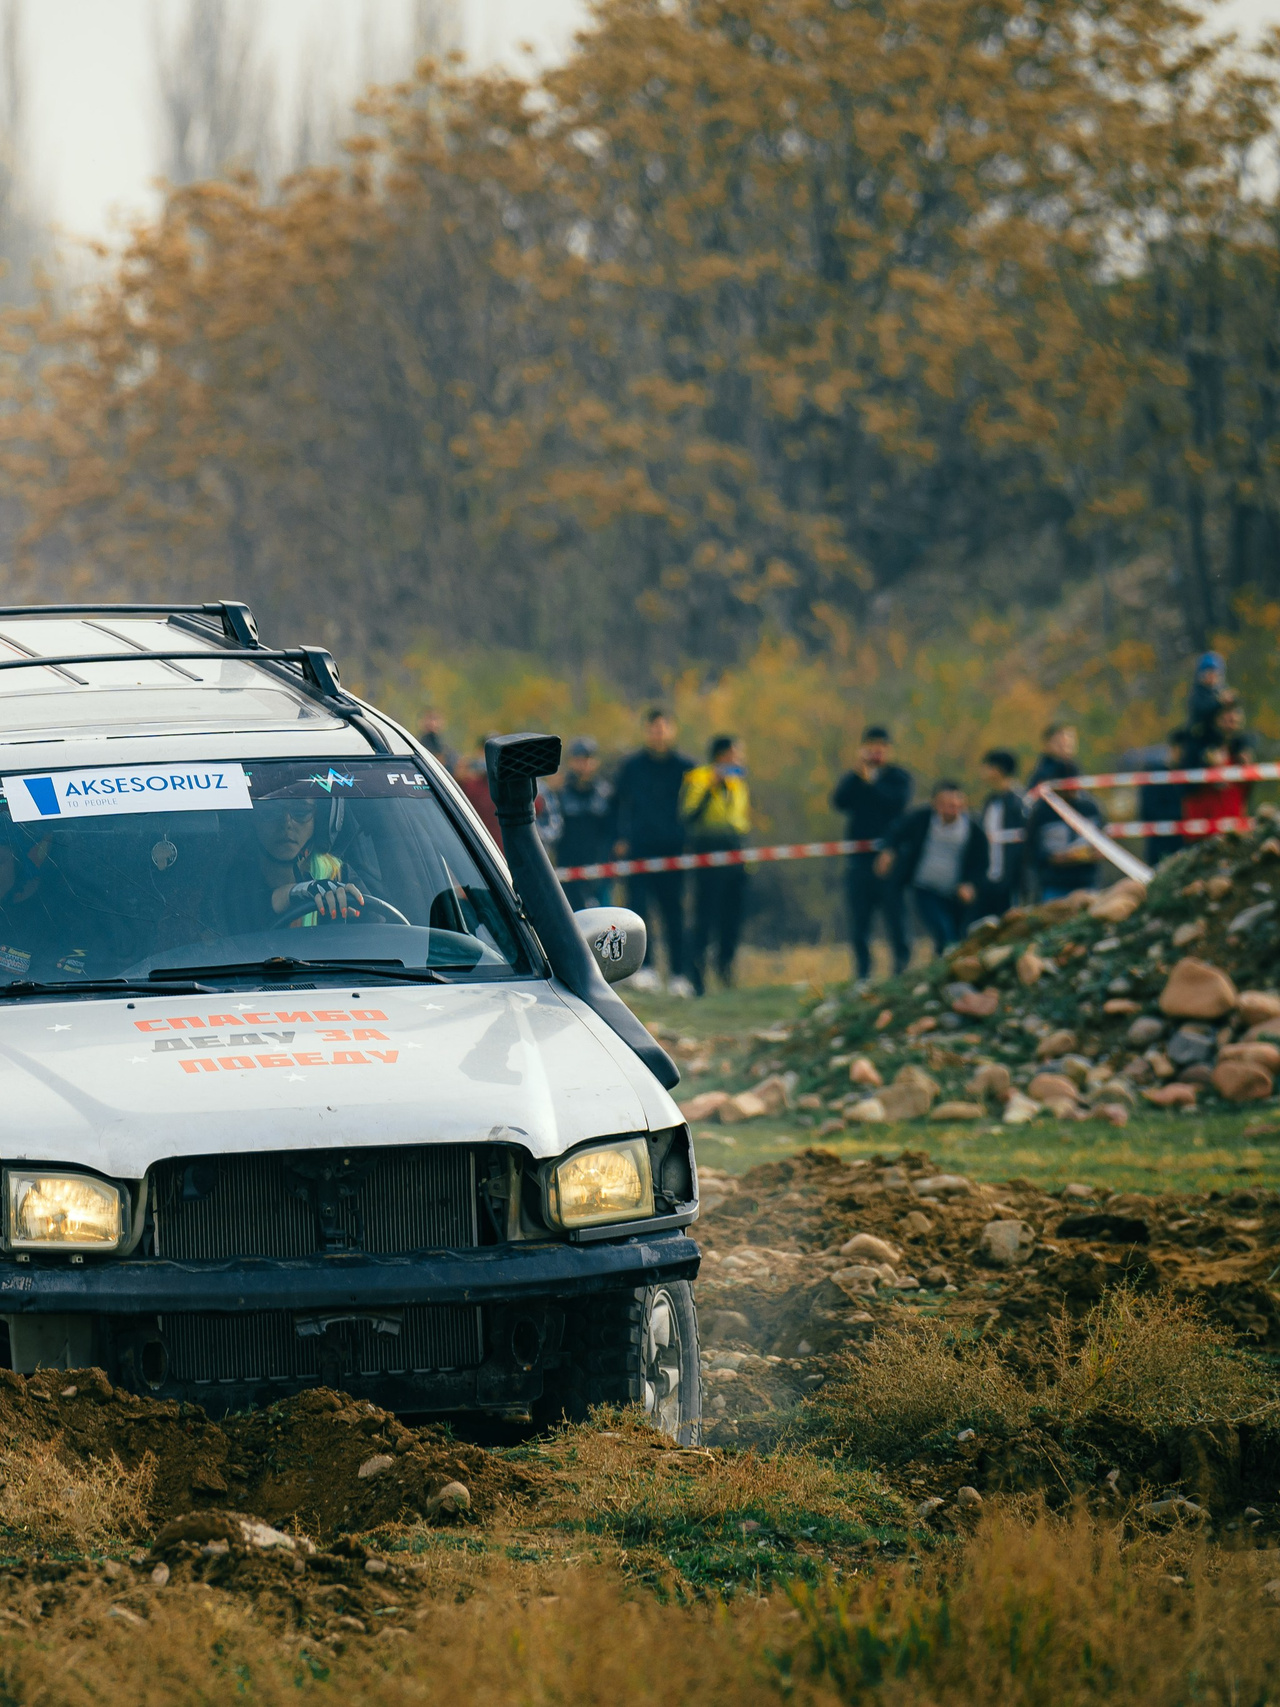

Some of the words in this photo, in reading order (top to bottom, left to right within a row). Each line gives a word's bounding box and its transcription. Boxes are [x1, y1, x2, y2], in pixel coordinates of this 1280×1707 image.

[65, 774, 229, 797] AKSESORIUZ
[67, 800, 79, 808] TO
[84, 797, 118, 807] PEOPLE
[133, 1009, 389, 1033] СПАСИБО
[151, 1030, 296, 1053] ДЕДУ
[313, 1028, 390, 1042] ЗА
[178, 1049, 400, 1074] ПОБЕДУ
